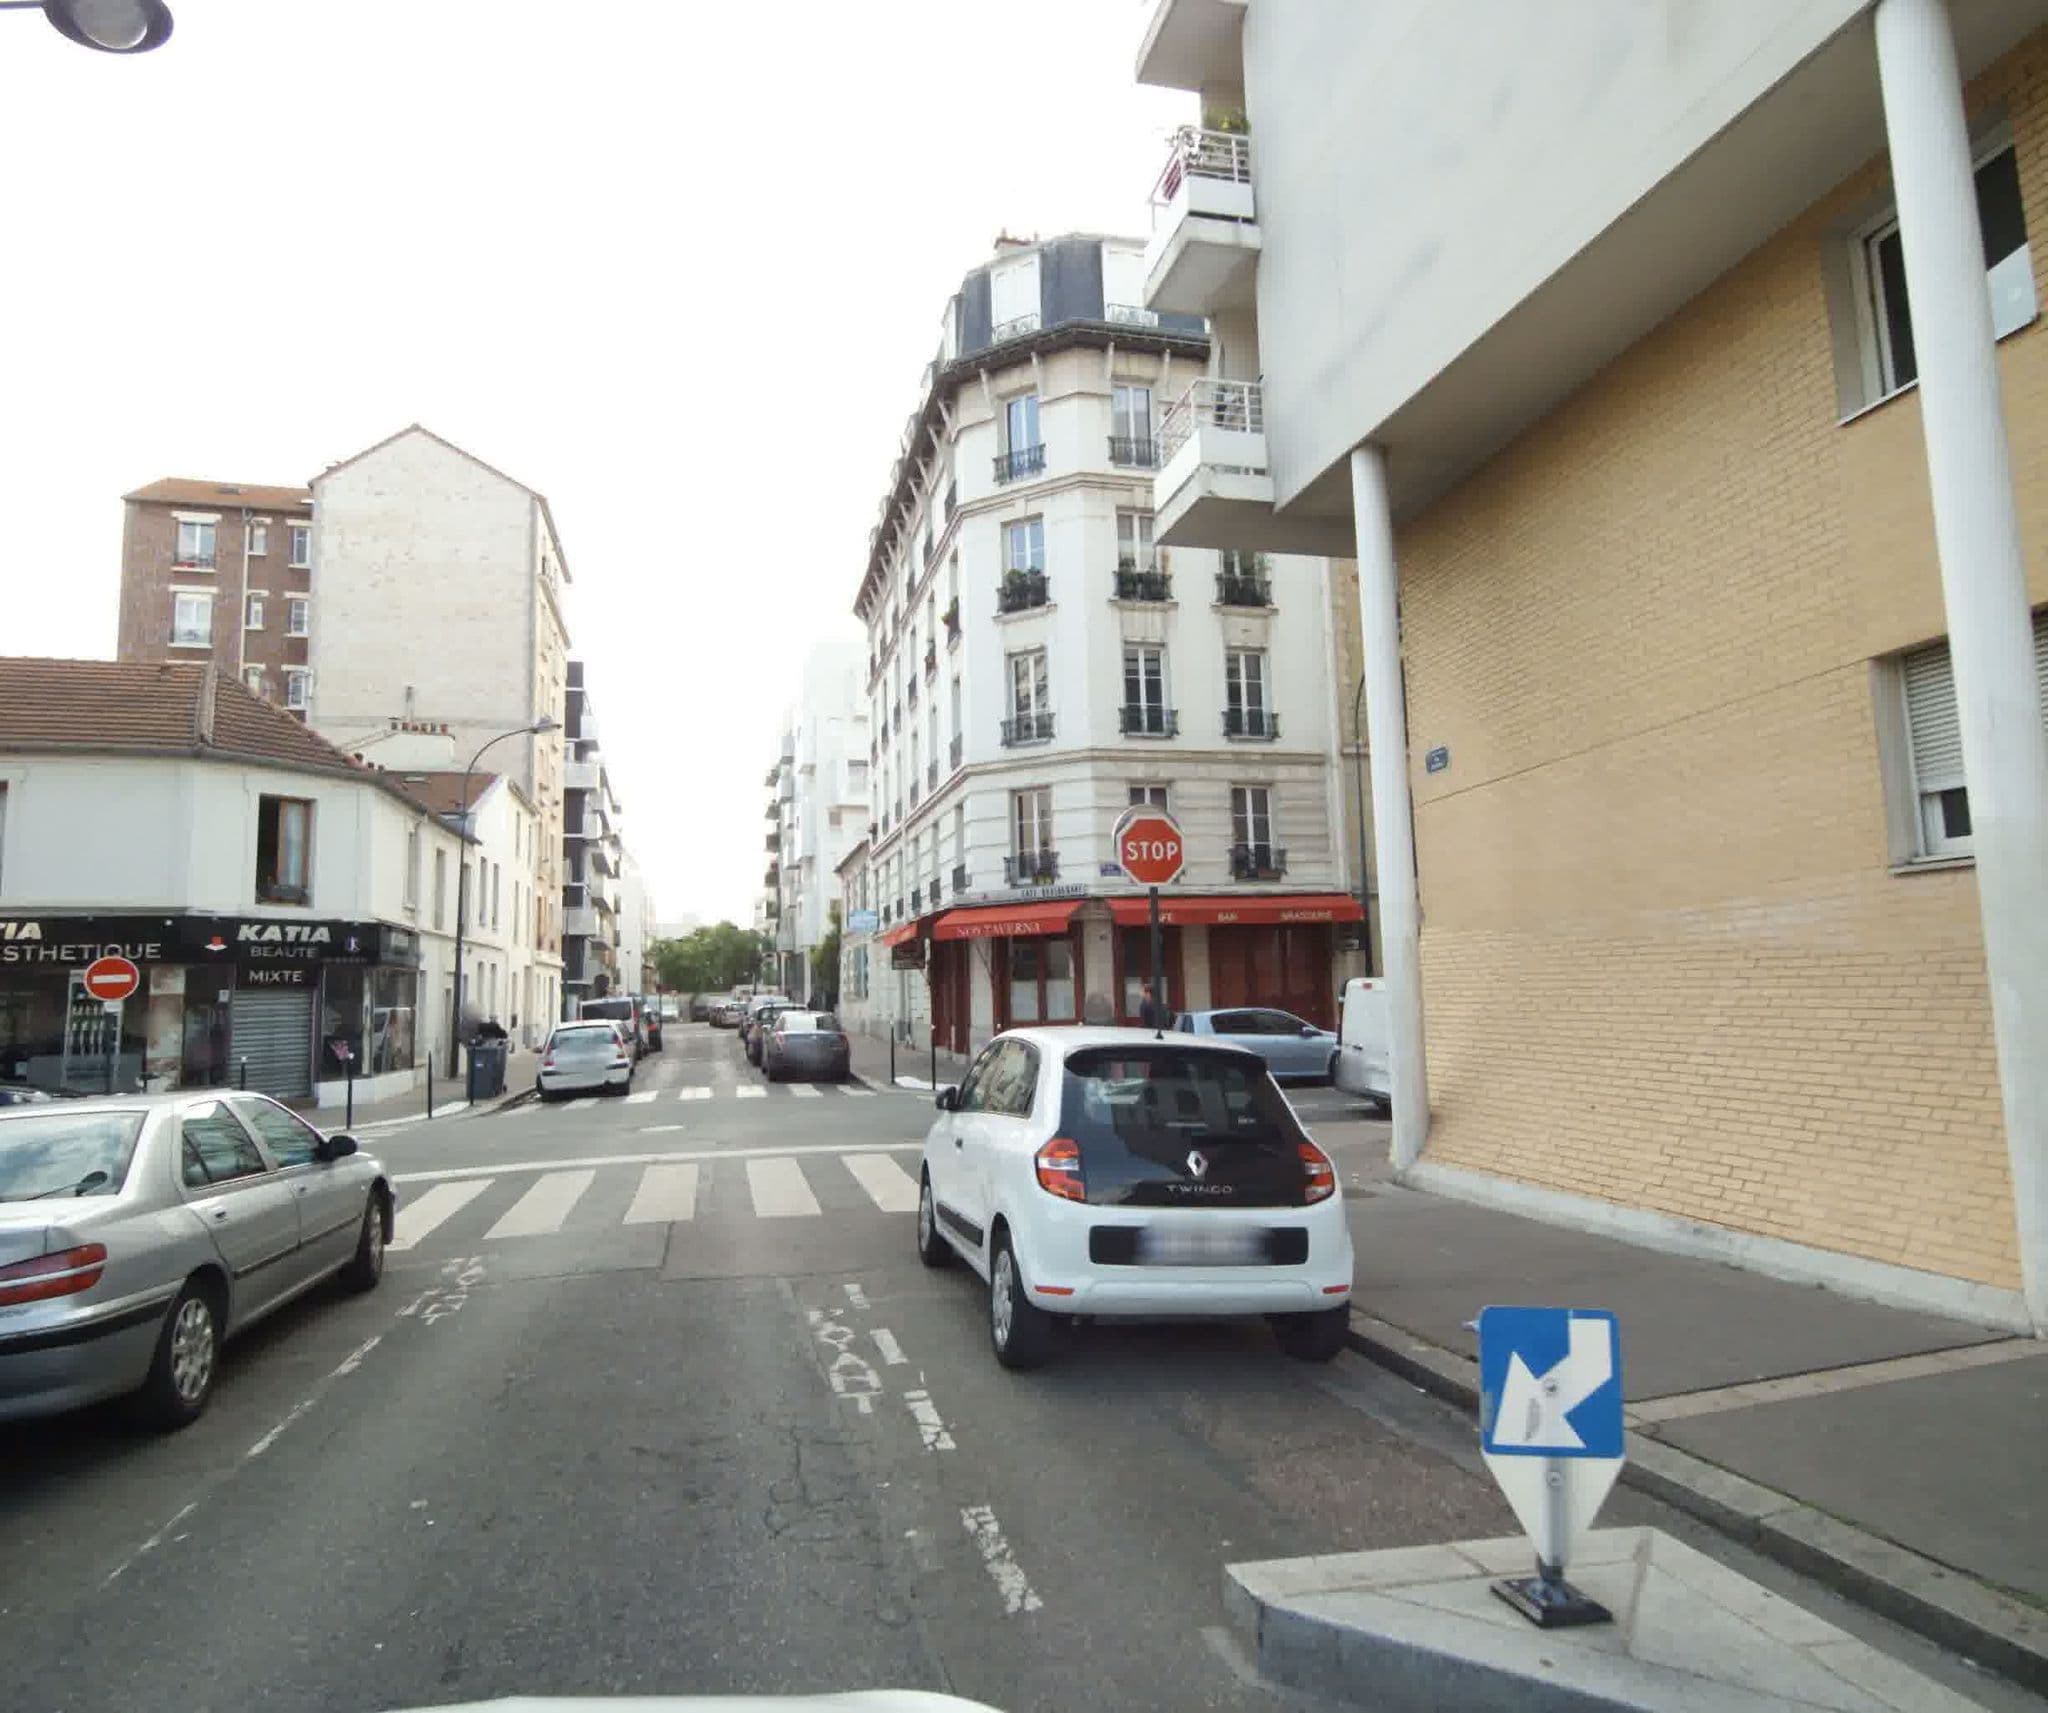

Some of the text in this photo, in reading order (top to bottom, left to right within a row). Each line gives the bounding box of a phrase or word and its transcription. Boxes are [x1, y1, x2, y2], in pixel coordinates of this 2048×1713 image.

[1126, 840, 1179, 861] STOP
[0, 922, 42, 940] IA
[236, 924, 331, 943] KATIA
[0, 943, 162, 962] STHETIQUE
[249, 970, 303, 984] MIXTE
[1166, 1184, 1233, 1194] TWINGO
